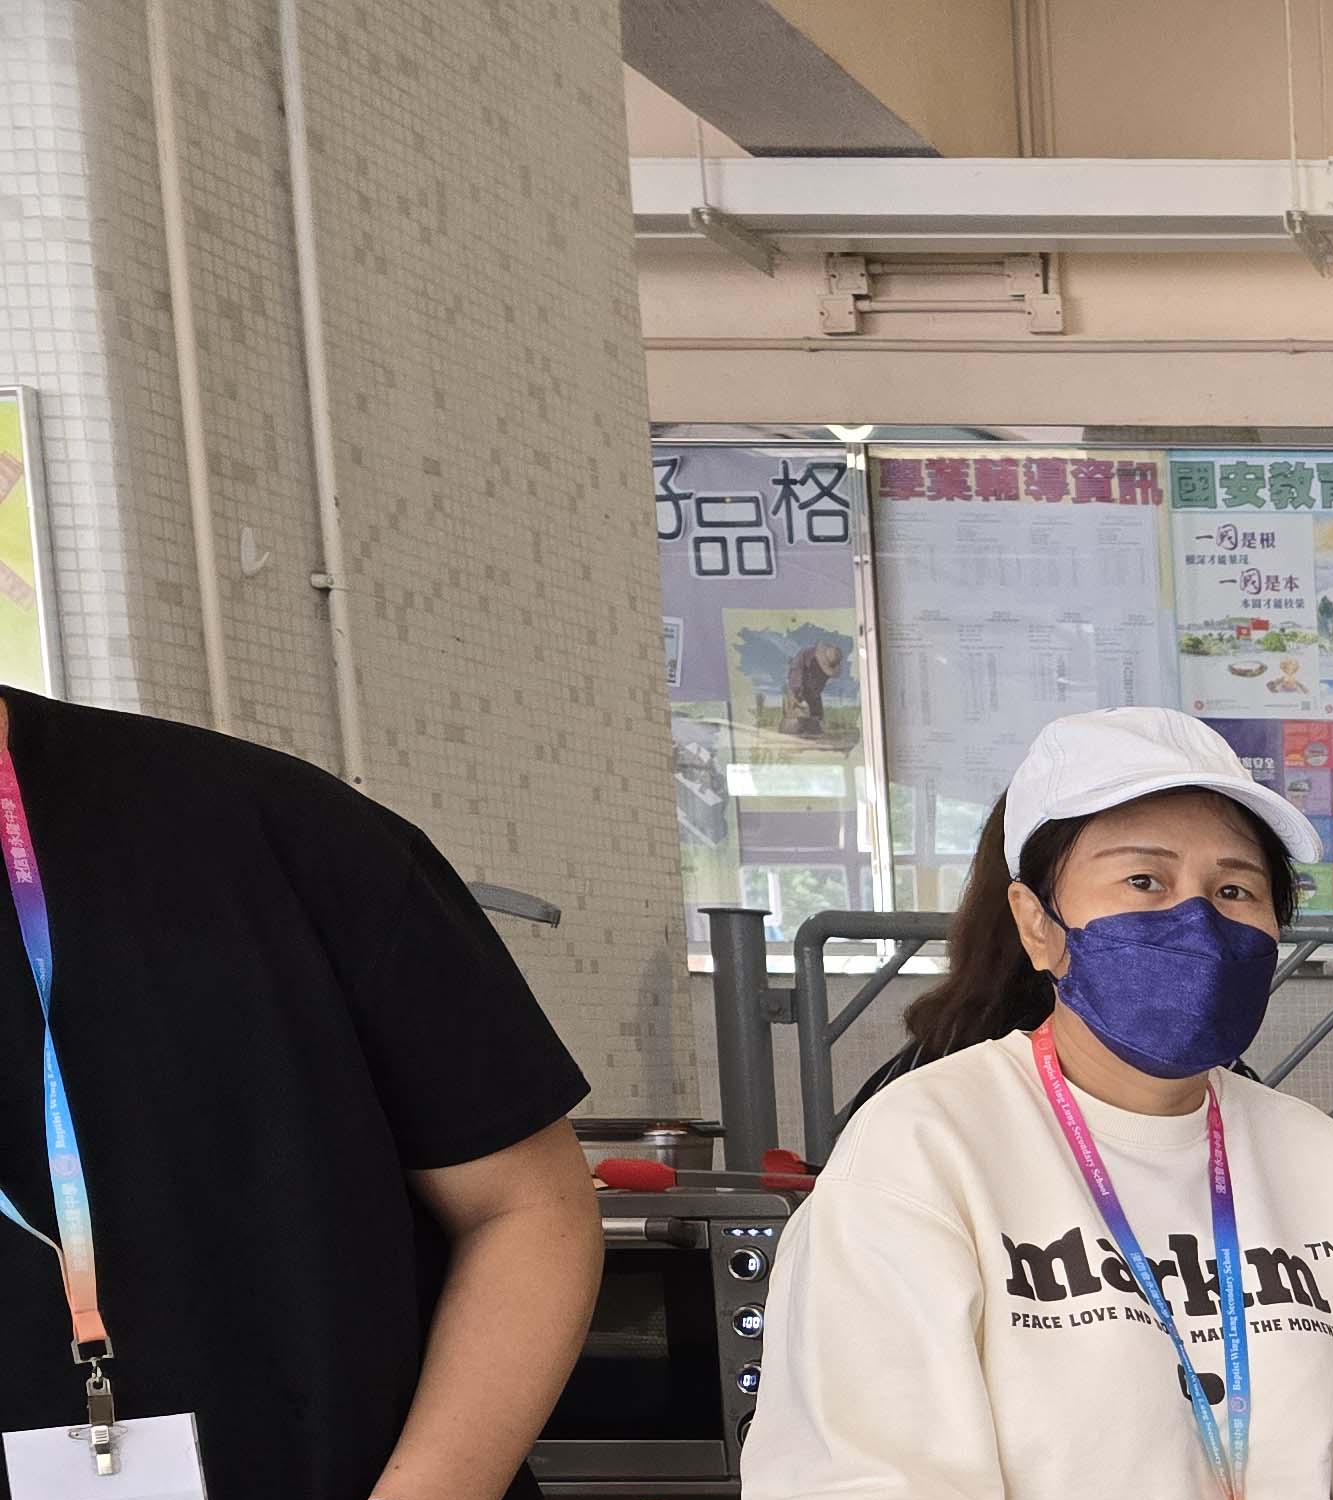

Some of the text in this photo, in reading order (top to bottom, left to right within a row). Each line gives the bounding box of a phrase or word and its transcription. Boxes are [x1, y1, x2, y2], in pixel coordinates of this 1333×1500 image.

[879, 457, 1163, 505] 學業輔導資訊
[1011, 1311, 1062, 1329] PEACE
[1070, 1306, 1118, 1327] LOVE
[1125, 1307, 1151, 1325] AND
[1190, 1327, 1224, 1343] MA
[1250, 1318, 1282, 1334] THE
